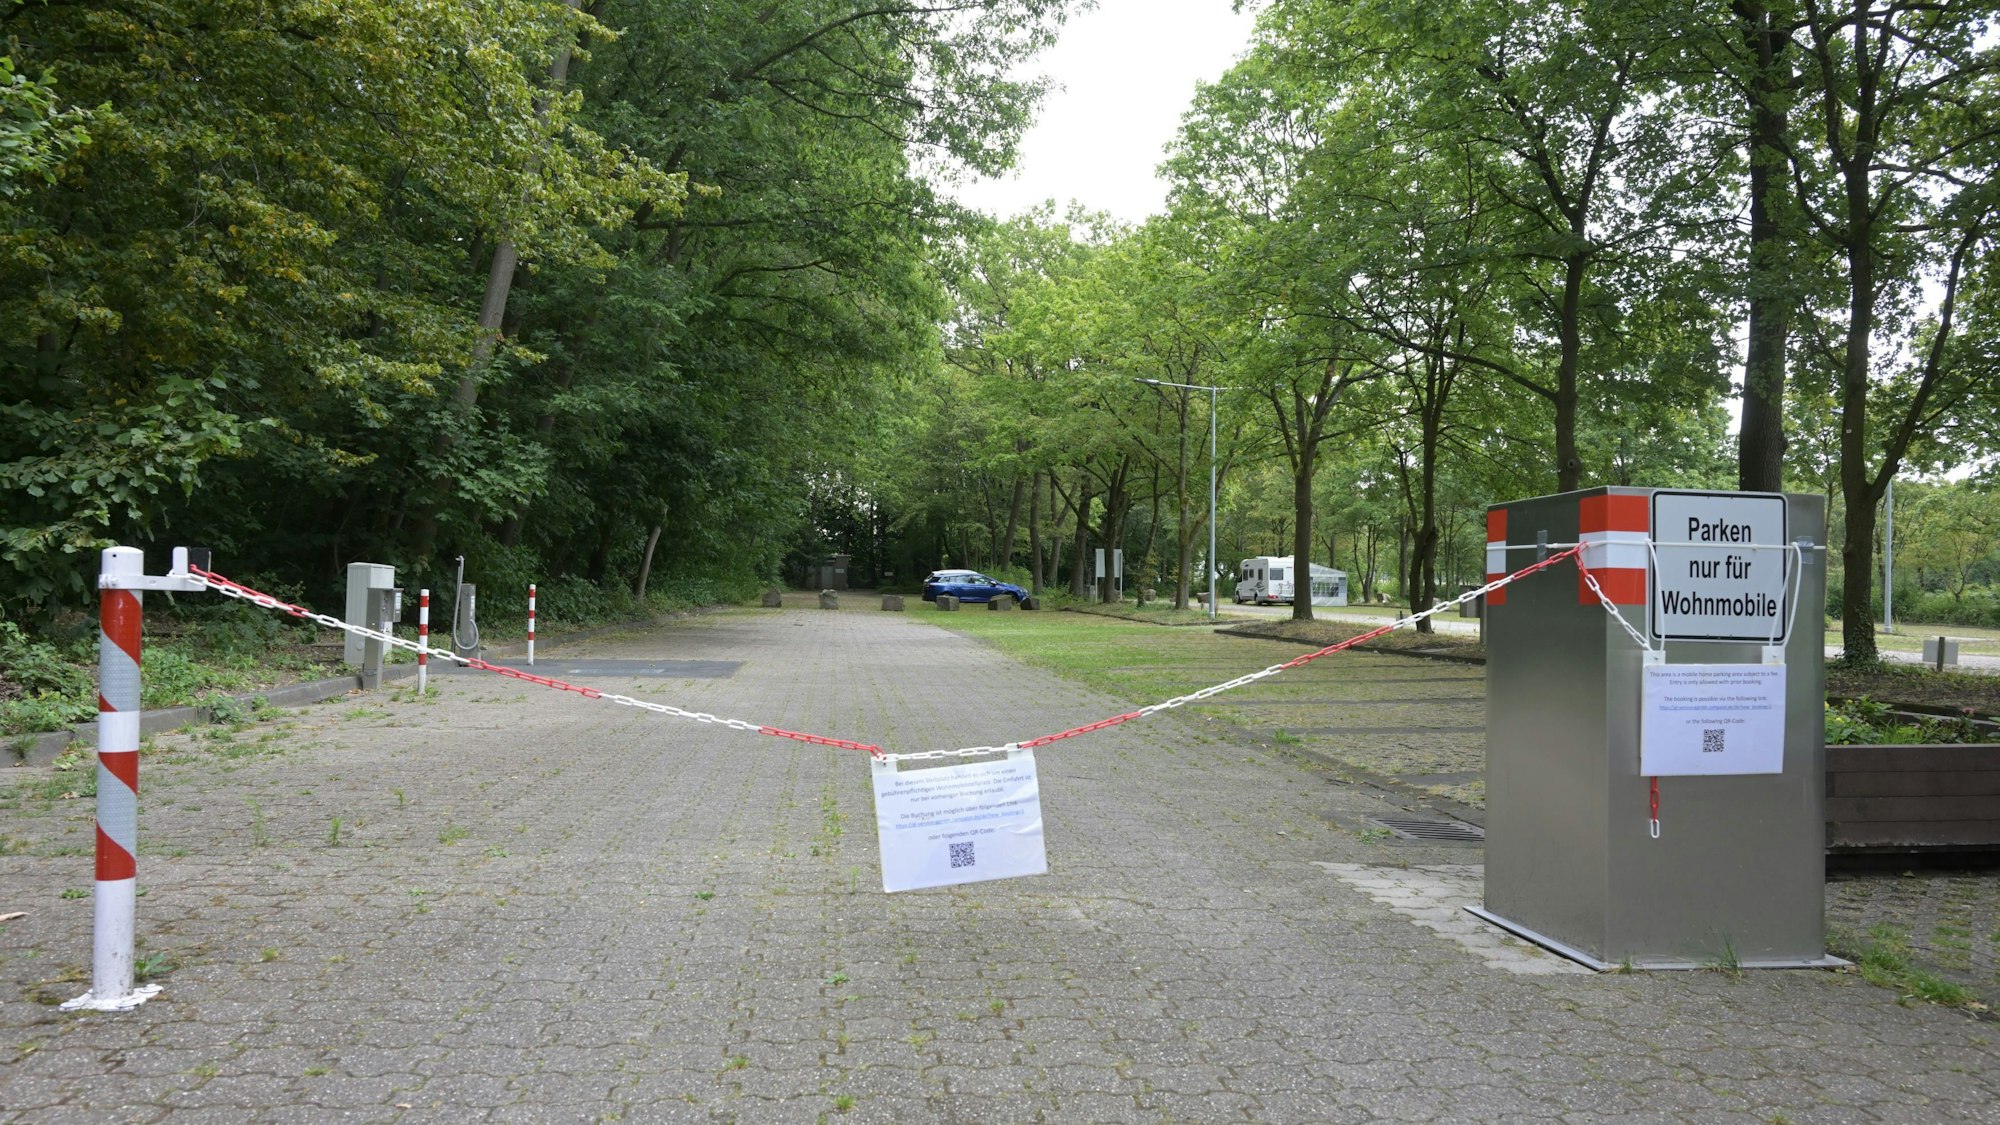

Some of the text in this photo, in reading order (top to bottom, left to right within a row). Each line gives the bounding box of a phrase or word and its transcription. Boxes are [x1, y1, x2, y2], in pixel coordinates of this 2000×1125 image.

[1689, 517, 1751, 543] Parken
[1690, 555, 1751, 579] nur für
[1661, 590, 1777, 617] Wohnmobile
[1003, 775, 1024, 783] Einfahrt
[910, 810, 934, 818] Buchung
[942, 806, 964, 814] möglich
[942, 830, 970, 840] folgenden
